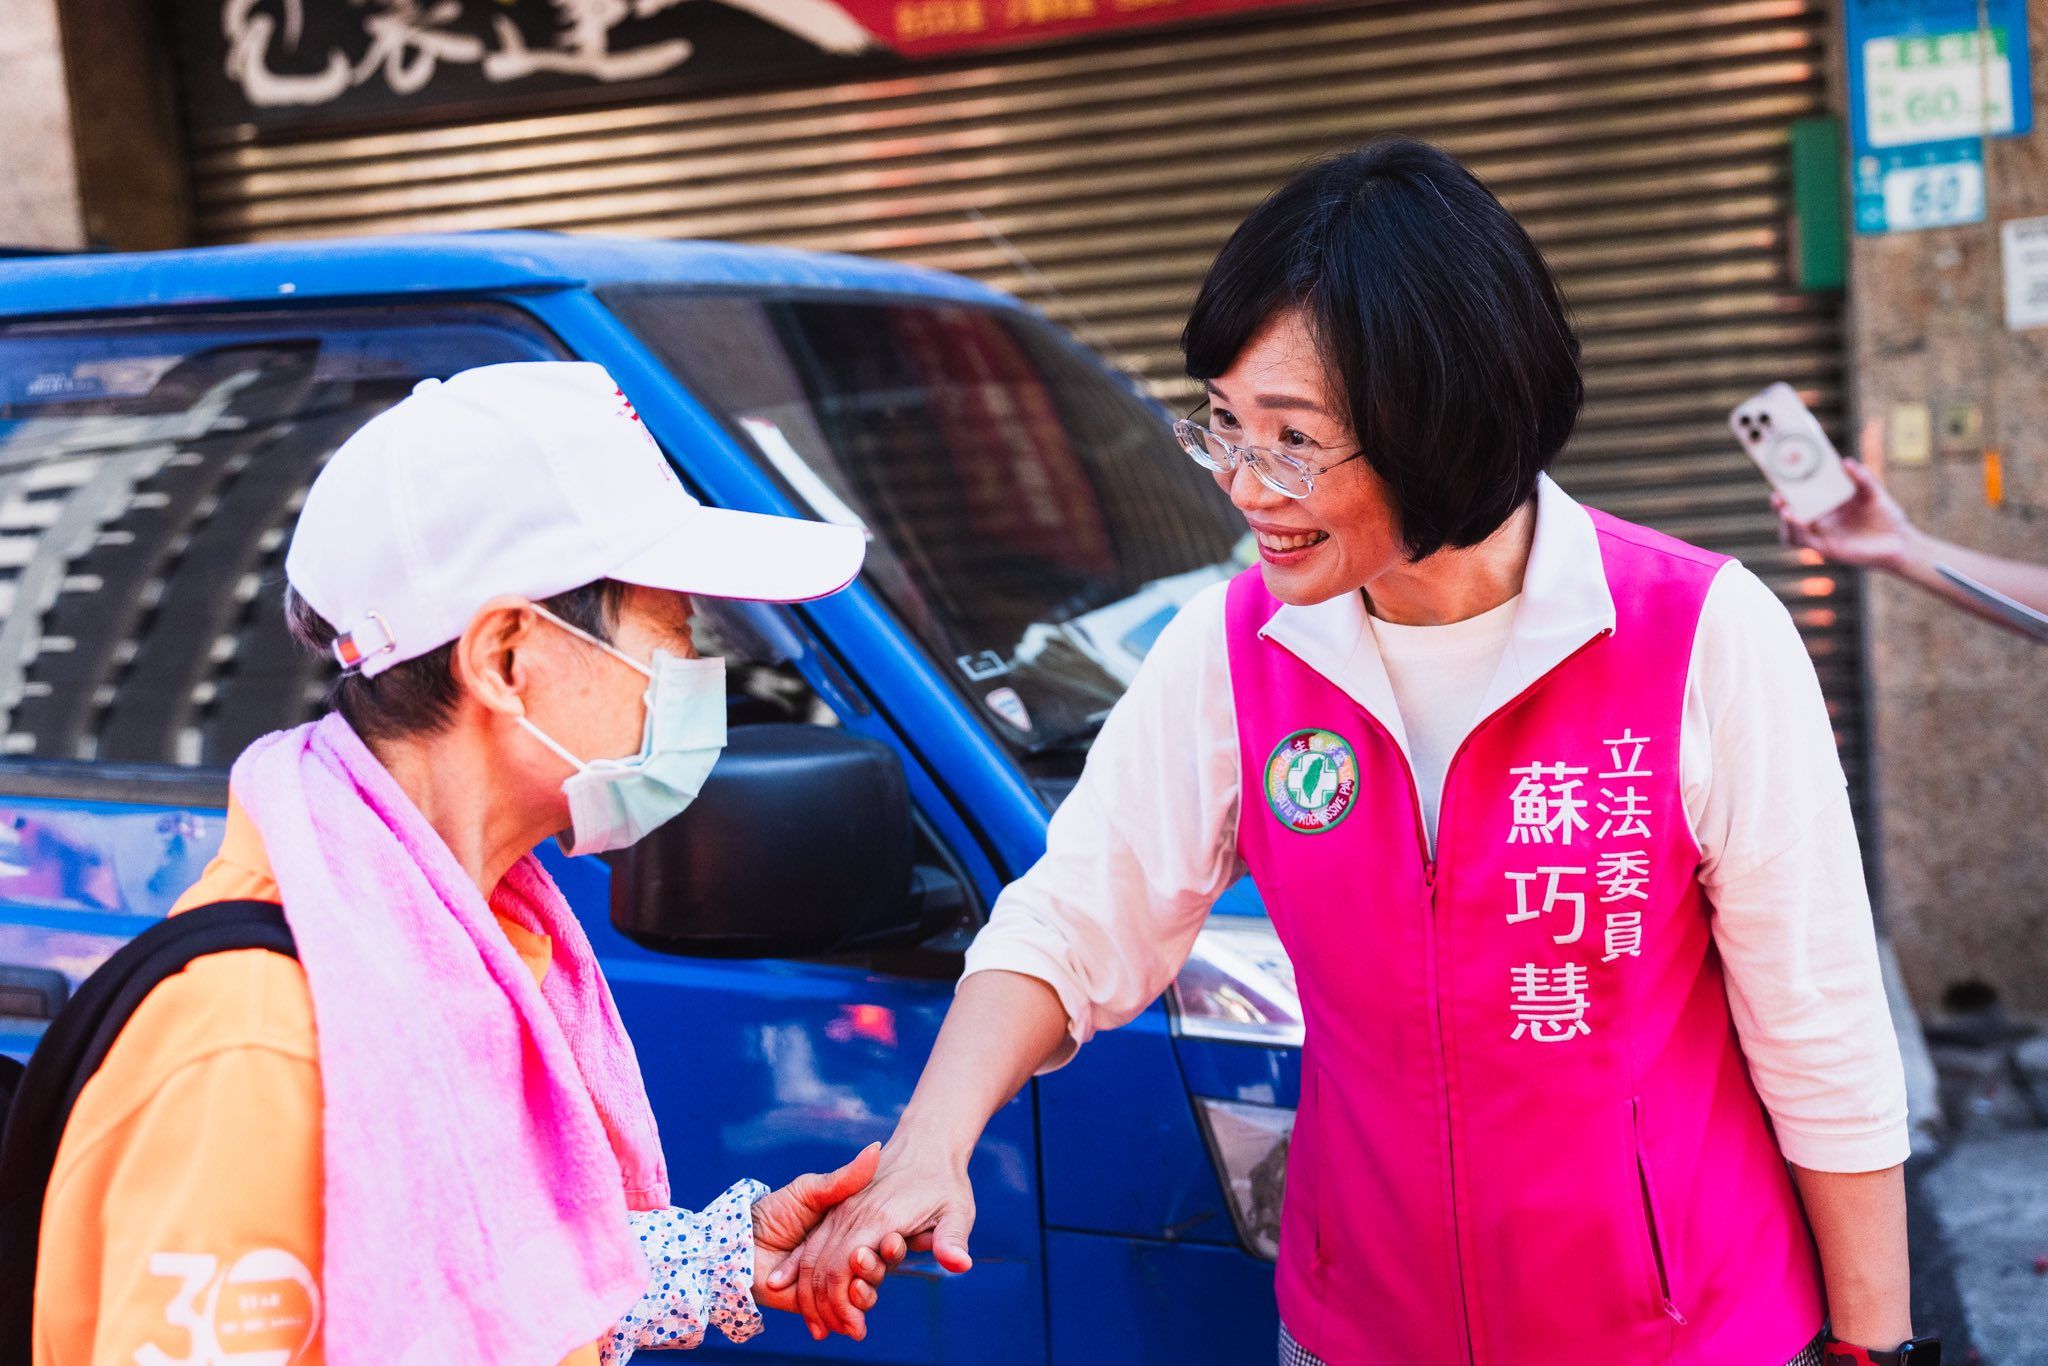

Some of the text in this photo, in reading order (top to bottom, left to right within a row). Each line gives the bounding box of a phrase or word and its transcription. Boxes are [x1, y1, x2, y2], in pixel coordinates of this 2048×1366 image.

[1503, 760, 1592, 1042] 蘇巧慧
[1595, 728, 1653, 963] 立法委員
[132, 1247, 322, 1366] 30
